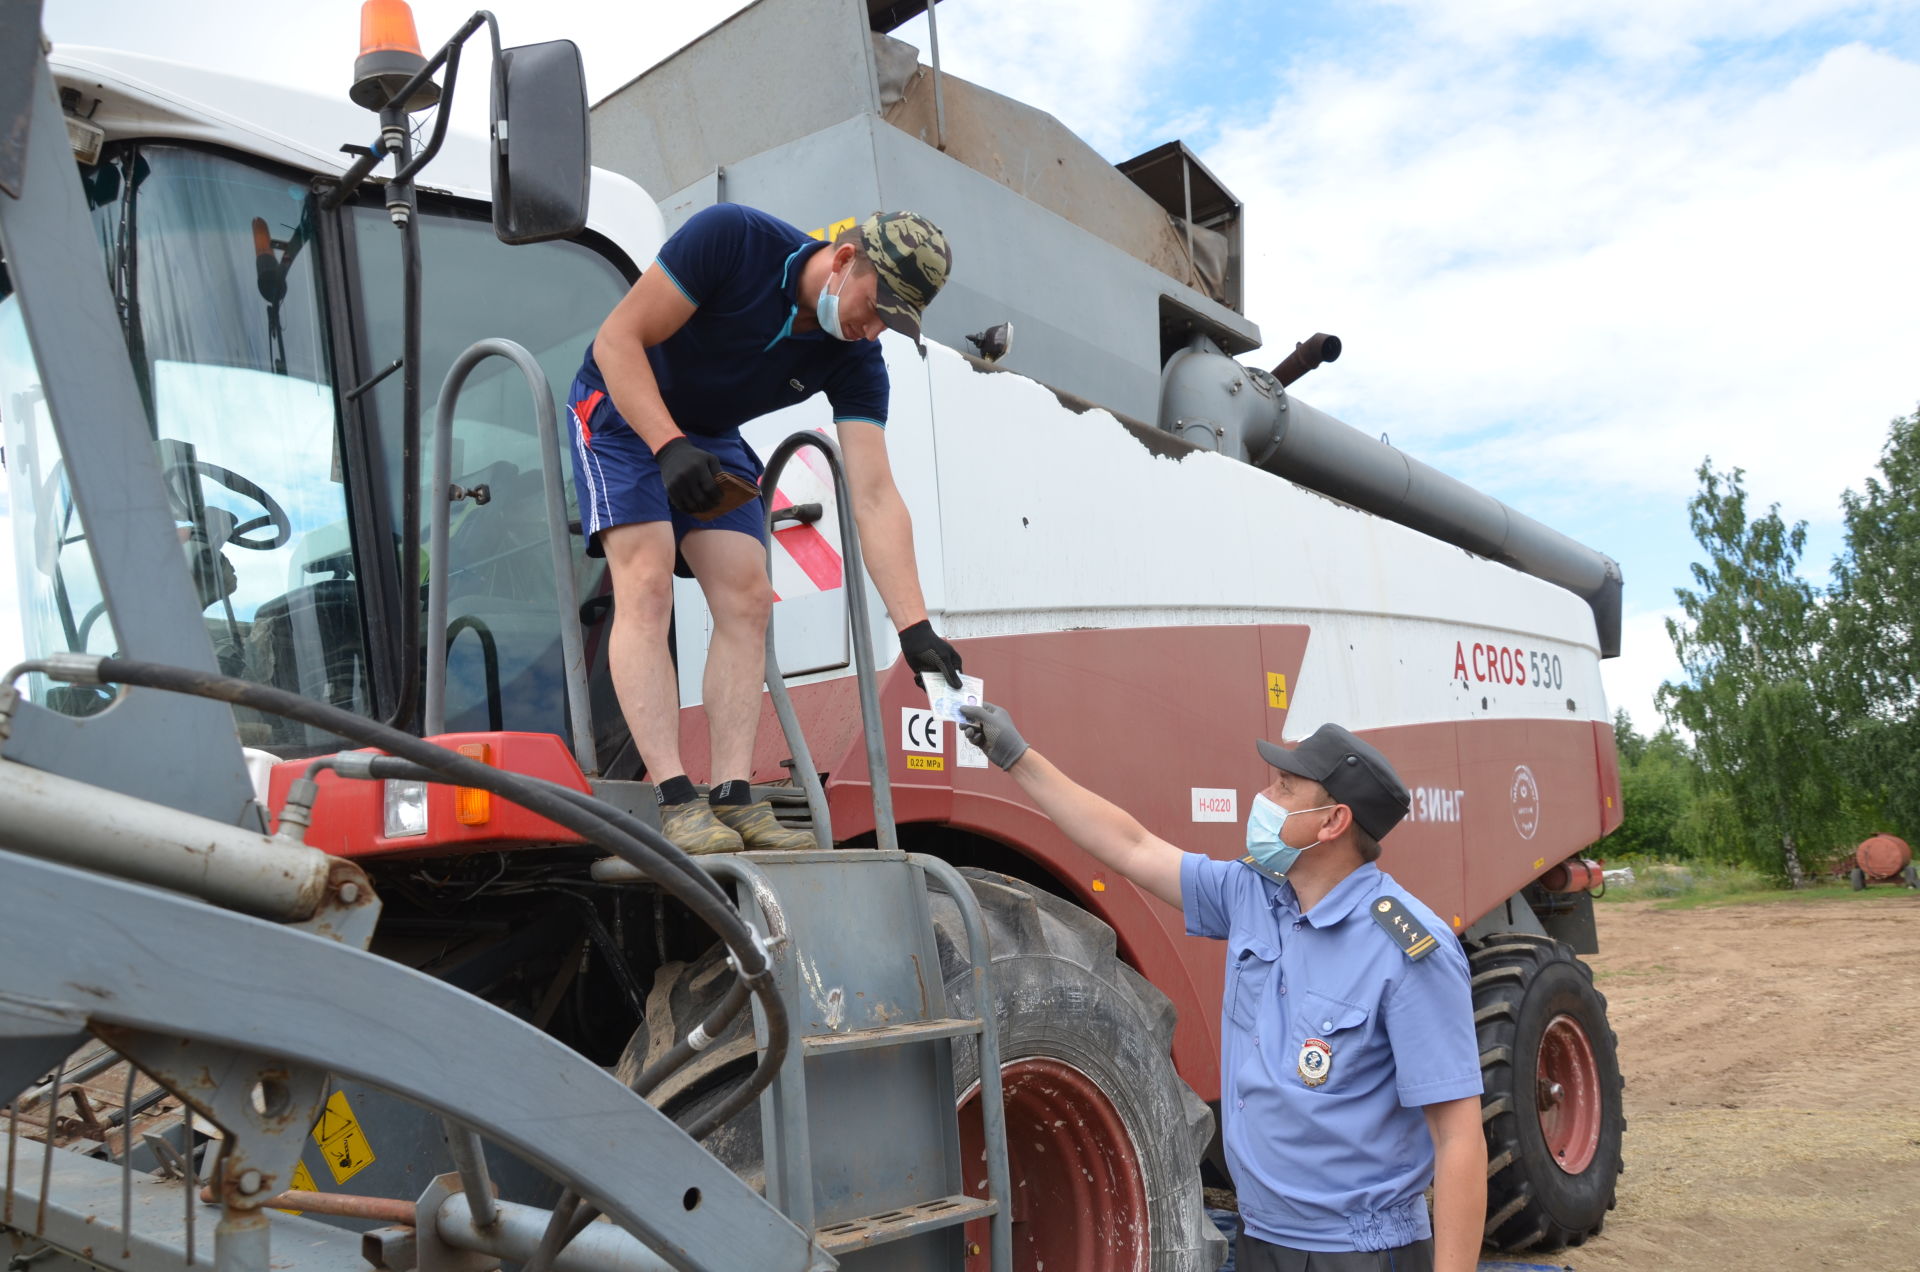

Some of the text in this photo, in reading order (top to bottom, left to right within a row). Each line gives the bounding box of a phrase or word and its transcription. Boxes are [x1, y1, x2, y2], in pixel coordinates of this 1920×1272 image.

[1454, 640, 1562, 690] ACROS 530
[908, 714, 937, 749] CE
[926, 759, 941, 769] MPa
